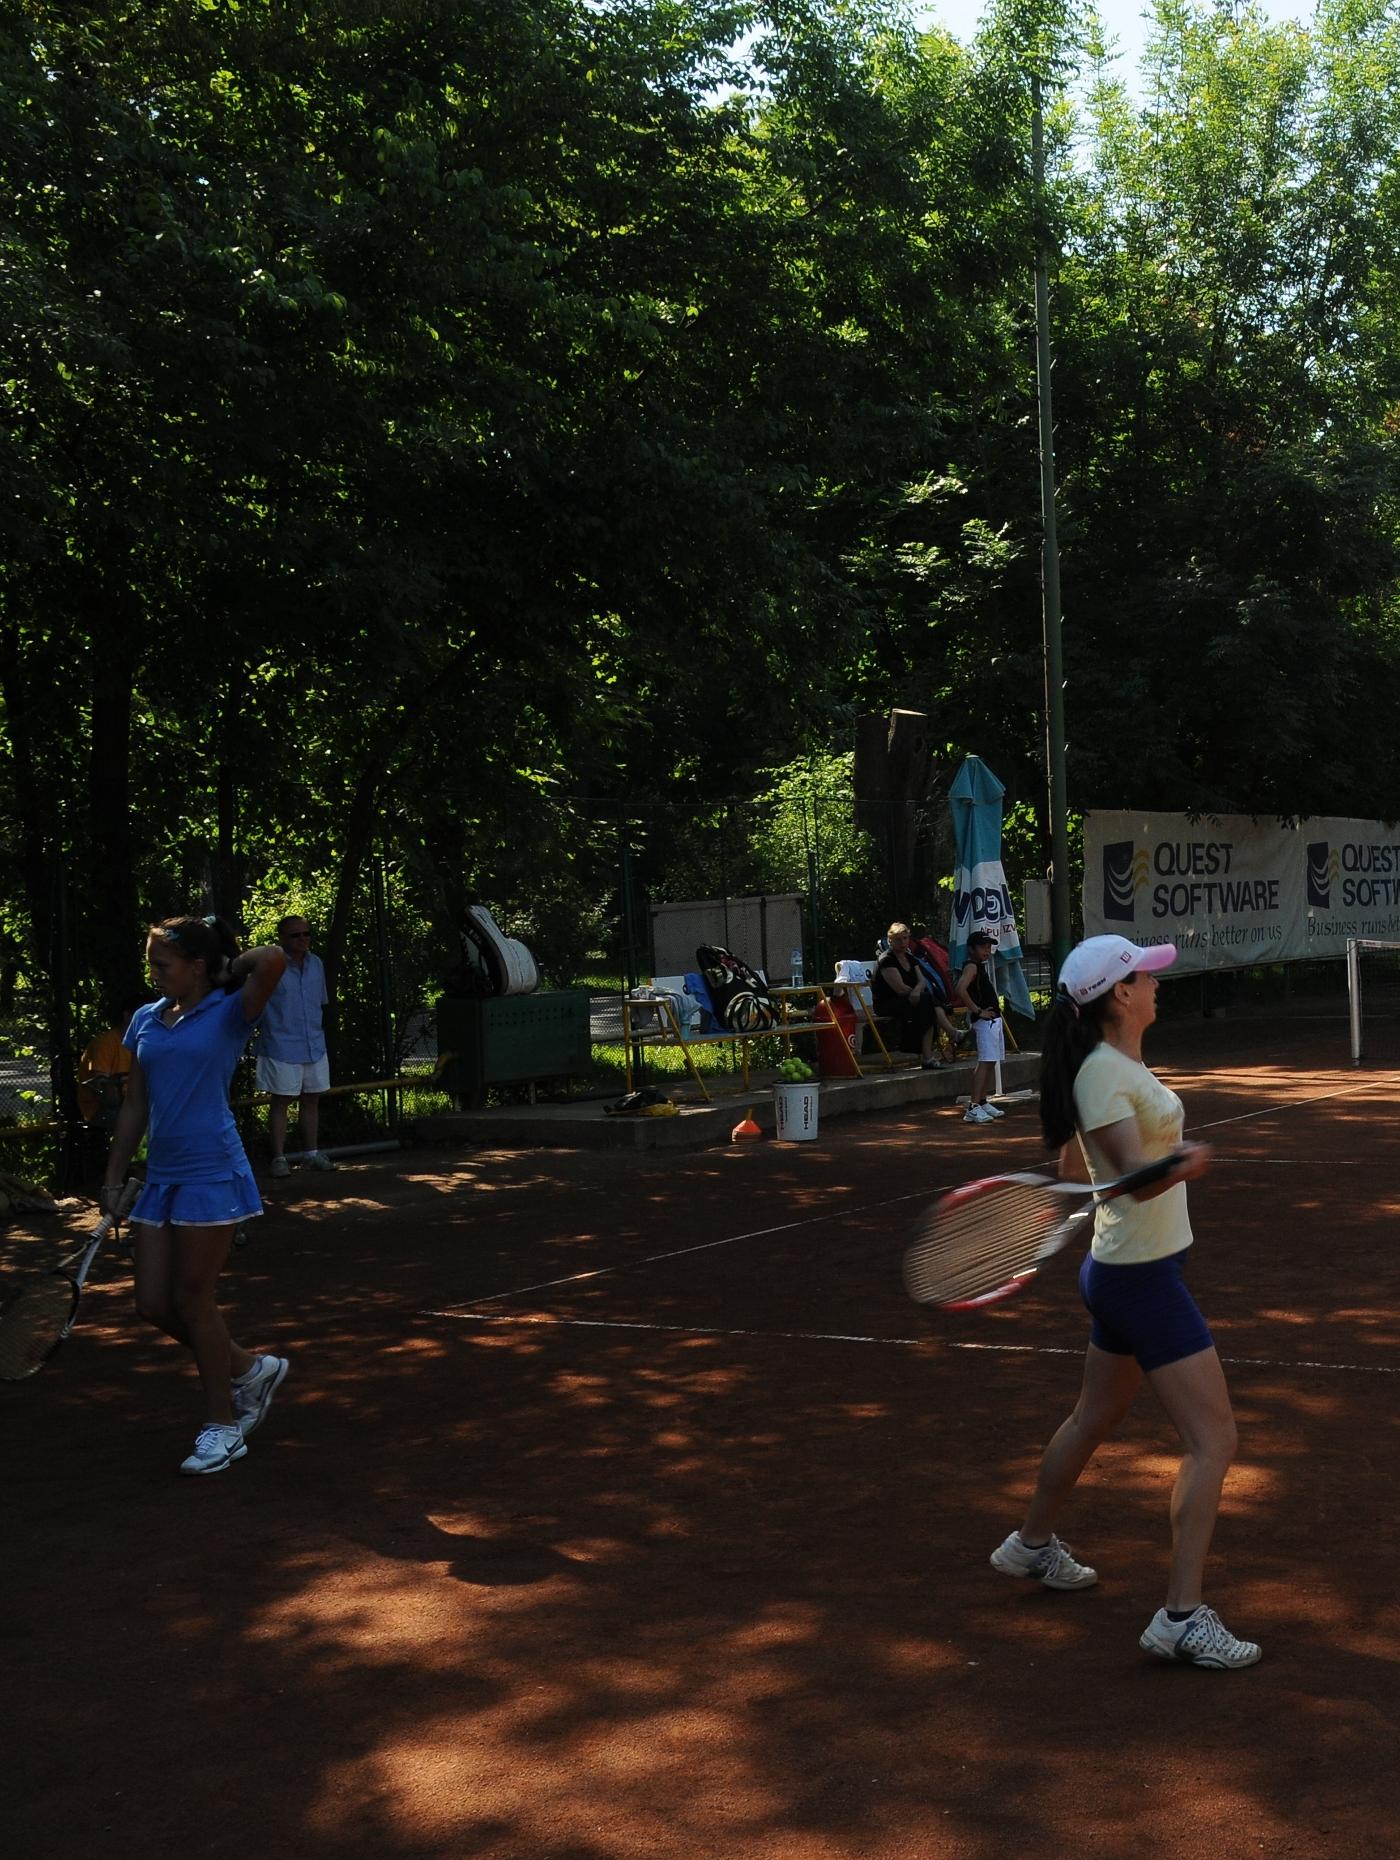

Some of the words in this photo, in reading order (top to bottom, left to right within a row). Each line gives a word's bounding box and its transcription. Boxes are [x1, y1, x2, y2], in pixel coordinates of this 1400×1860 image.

[1152, 841, 1234, 876] QUEST
[1341, 842, 1400, 874] QUEST
[1151, 880, 1280, 918] SOFTWARE
[1173, 931, 1209, 951] runs
[1211, 924, 1249, 947] better
[1250, 926, 1267, 944] on
[1267, 924, 1282, 941] us
[1306, 915, 1358, 937] Business
[1360, 919, 1388, 935] runs
